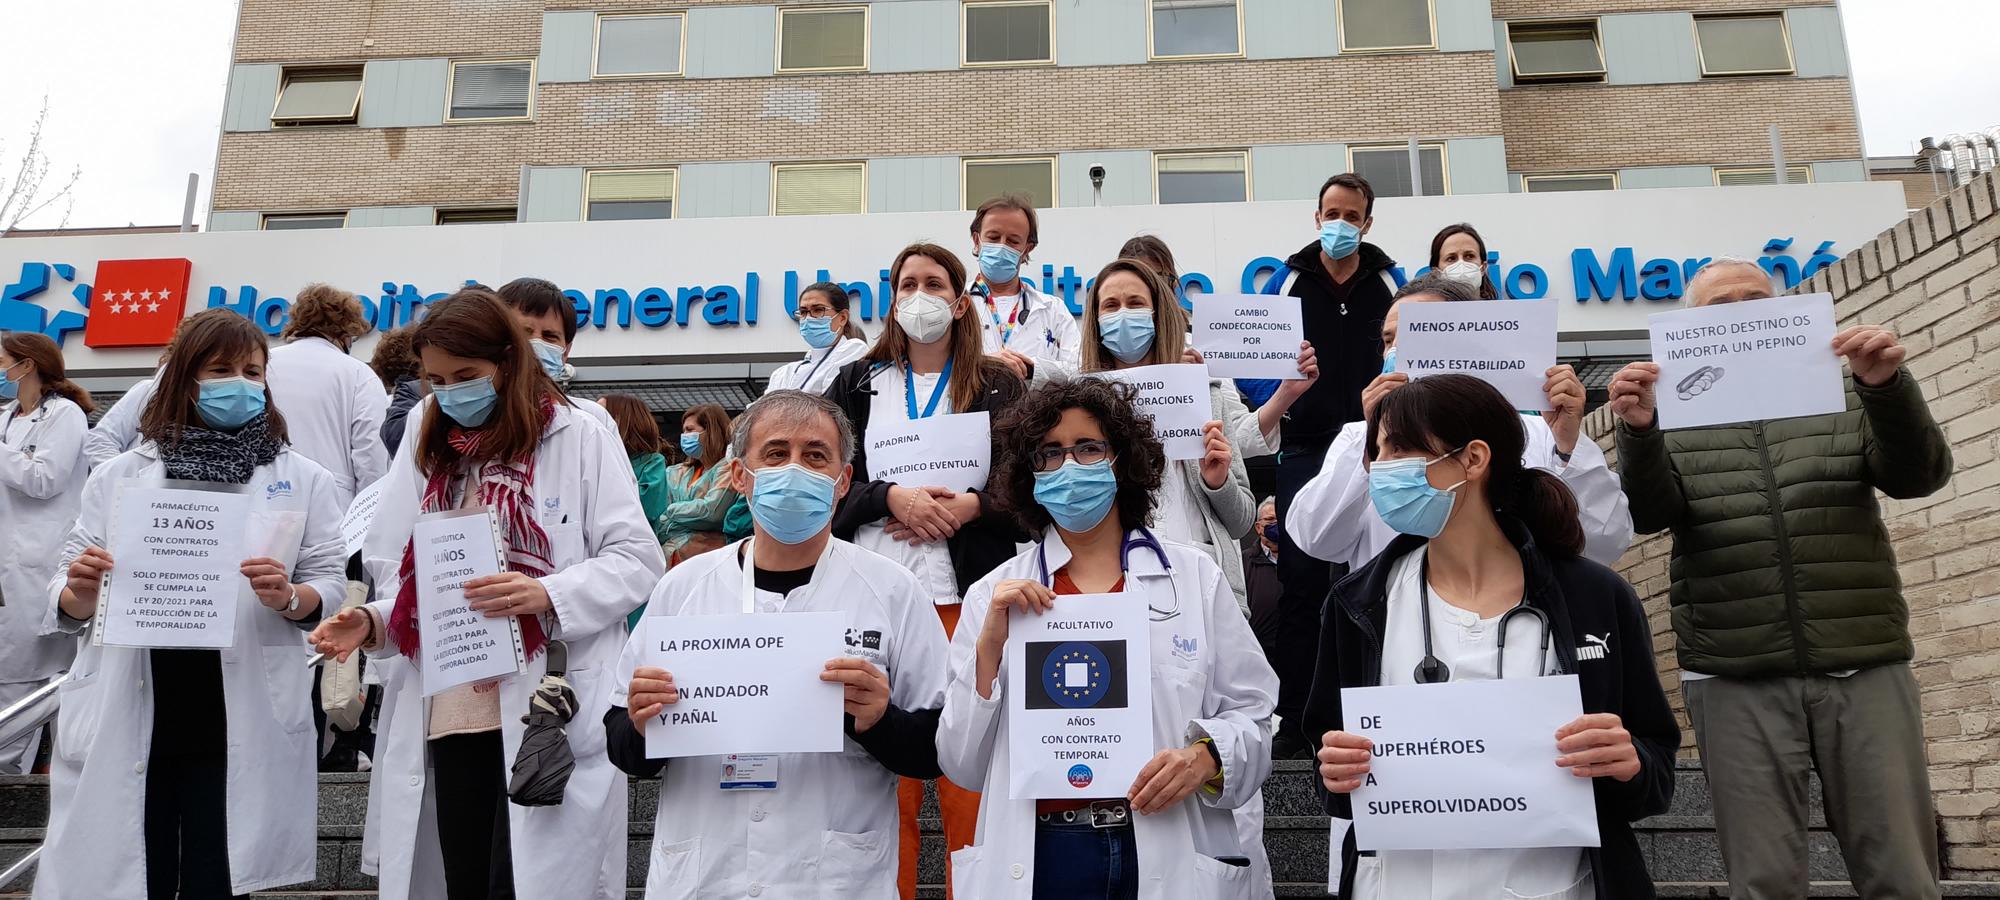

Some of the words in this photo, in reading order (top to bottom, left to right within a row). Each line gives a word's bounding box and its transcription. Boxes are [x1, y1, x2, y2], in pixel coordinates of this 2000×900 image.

[1234, 308, 1269, 317] CAMBIO
[1209, 322, 1292, 331] CONDECORACIONES
[1409, 321, 1455, 333] MENOS
[1458, 320, 1519, 332] APLAUSOS
[1665, 324, 1727, 343] NUESTRO
[1731, 316, 1790, 334] DESTINO
[1792, 314, 1811, 327] OS
[1243, 336, 1261, 345] POR
[1667, 344, 1729, 361] IMPORTA
[1733, 341, 1753, 353] UN
[1757, 334, 1807, 350] PEPINO
[1203, 351, 1258, 360] ESTABILIDAD
[1261, 351, 1298, 360] LABORAL
[1407, 360, 1414, 370] Y
[1417, 360, 1445, 371] MAS
[1449, 359, 1525, 371] ESTABILIDAD
[1157, 428, 1203, 439] LABORAL
[873, 433, 921, 450] APADRINA
[876, 469, 888, 480] UN
[889, 462, 928, 477] MEDICO
[930, 459, 980, 470] EVENTUAL
[151, 501, 220, 513] FARMACÉUTICA
[152, 518, 169, 529] 13
[173, 517, 215, 531] AÑOS
[143, 536, 163, 544] CON
[165, 537, 219, 546] CONTRATOS
[151, 548, 209, 557] TEMPORALES
[133, 571, 157, 580] SOLO
[159, 572, 200, 581] PEDIMOS
[202, 573, 220, 582] QUE
[143, 583, 155, 591] SE
[156, 584, 194, 592] CUMPLA
[196, 585, 207, 593] LA
[134, 597, 150, 605] LEY
[151, 597, 187, 606] 20/2021
[189, 598, 213, 606] PARA
[139, 608, 192, 618] REDUCCIÓN
[194, 610, 205, 618] DE
[136, 621, 206, 630] TEMPORALIDAD
[1047, 621, 1113, 630] FACULTATIVO
[465, 629, 488, 639] PARA
[472, 642, 483, 650] DE
[661, 639, 677, 652] LA
[682, 637, 751, 651] PROXIMA
[756, 637, 784, 648] OPE
[694, 684, 769, 699] ANDADOR
[659, 714, 668, 726] Y
[672, 709, 718, 726] PAÑAL
[1067, 715, 1096, 726] AÑOS
[1360, 715, 1382, 730] DE
[1041, 735, 1064, 744] CON
[1066, 734, 1121, 744] CONTRATO
[1368, 738, 1485, 758] UPERHÉROES
[1054, 751, 1110, 760] TEMPORAL
[1365, 773, 1378, 787] A
[1368, 796, 1527, 815] SUPEROLVIDADOS
